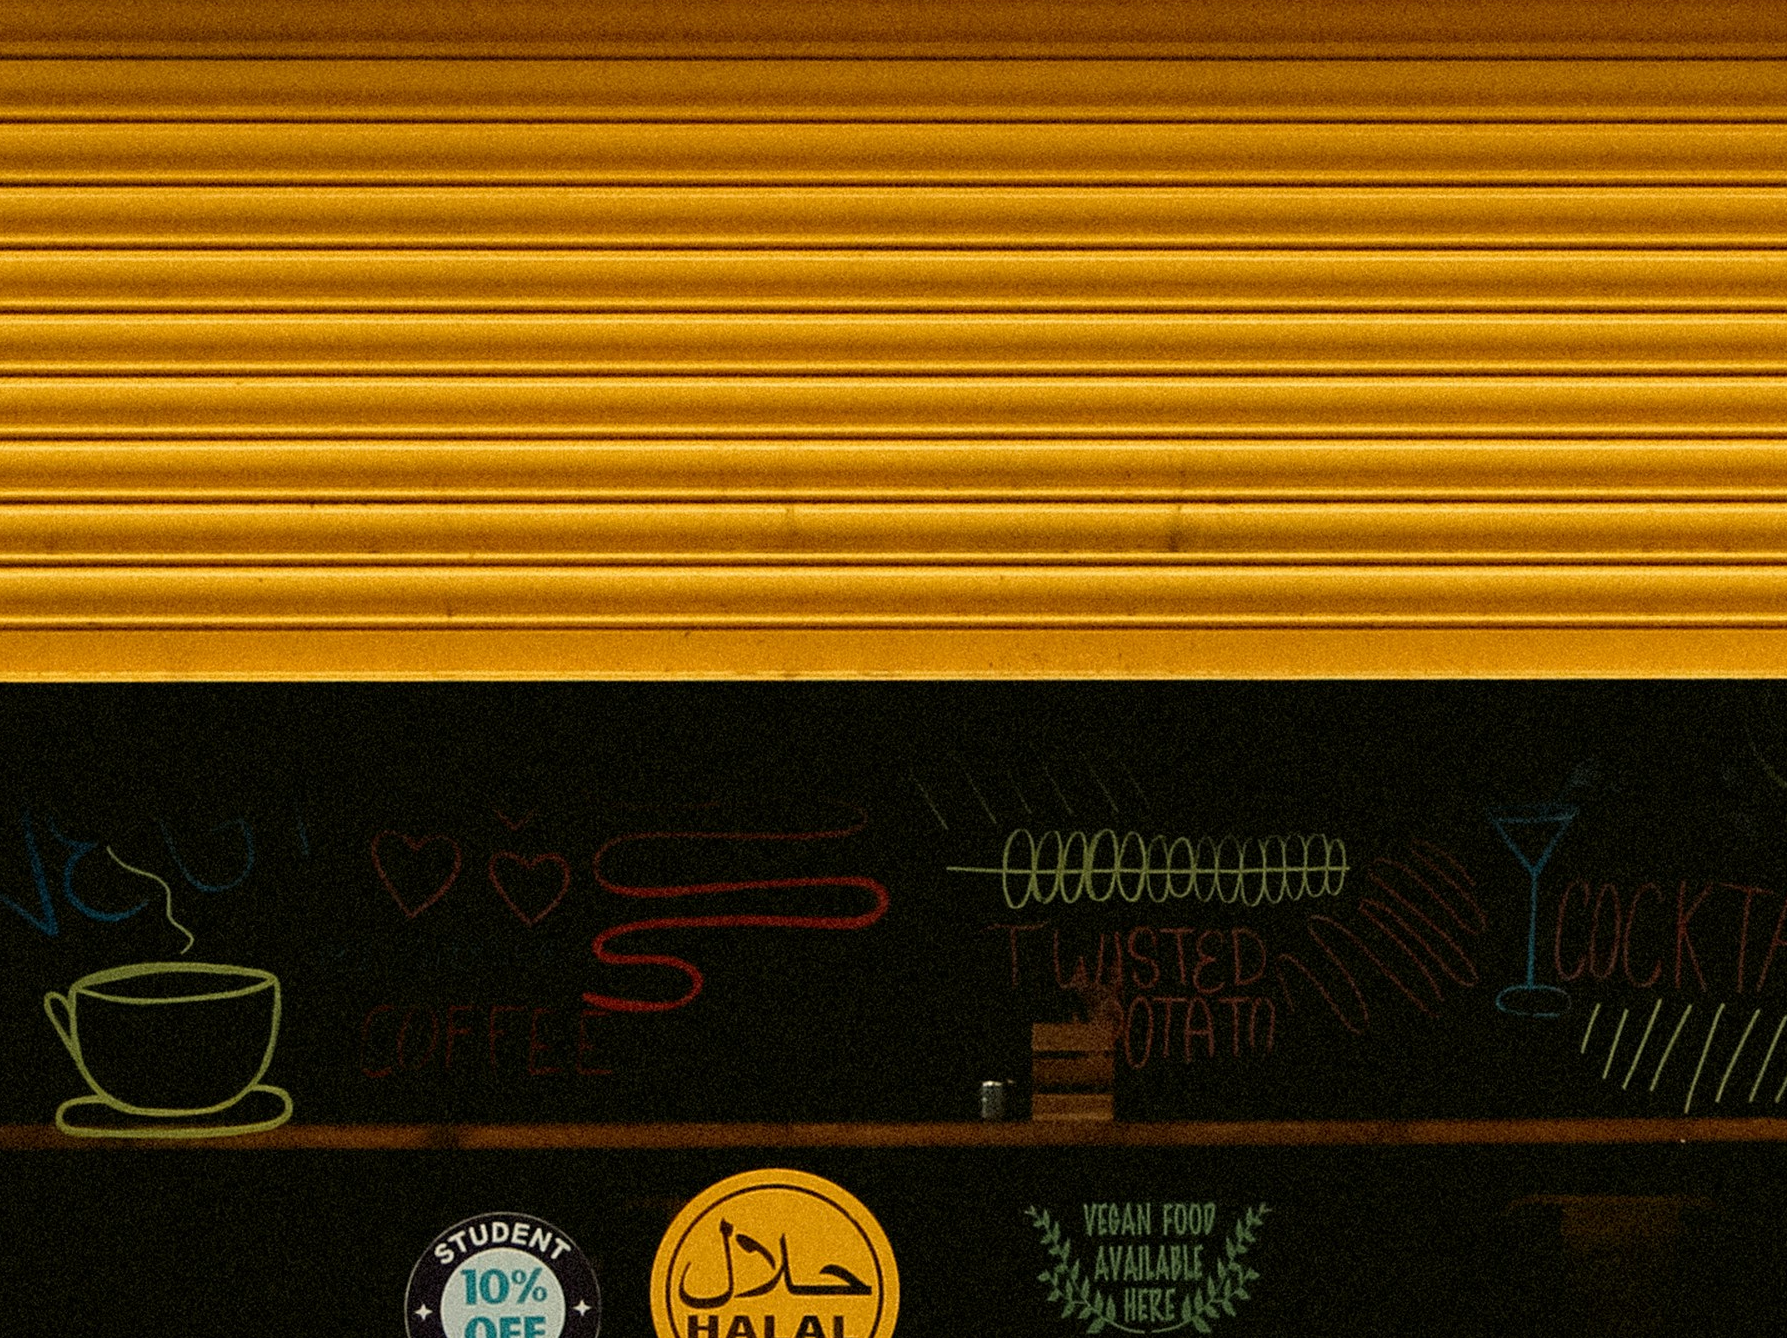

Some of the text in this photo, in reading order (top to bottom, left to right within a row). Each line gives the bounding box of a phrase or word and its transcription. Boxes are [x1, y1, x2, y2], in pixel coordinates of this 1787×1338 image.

[982, 919, 1268, 996] TWISTED
[362, 1003, 613, 1079] COFFEE
[1082, 1201, 1217, 1237] VEGAN FOOD
[433, 1221, 573, 1266] STUDENT
[678, 1217, 872, 1310] حلال
[1093, 1244, 1204, 1282] AVAILABLE
[460, 1266, 548, 1305] 10%
[1122, 1287, 1177, 1323] HERE
